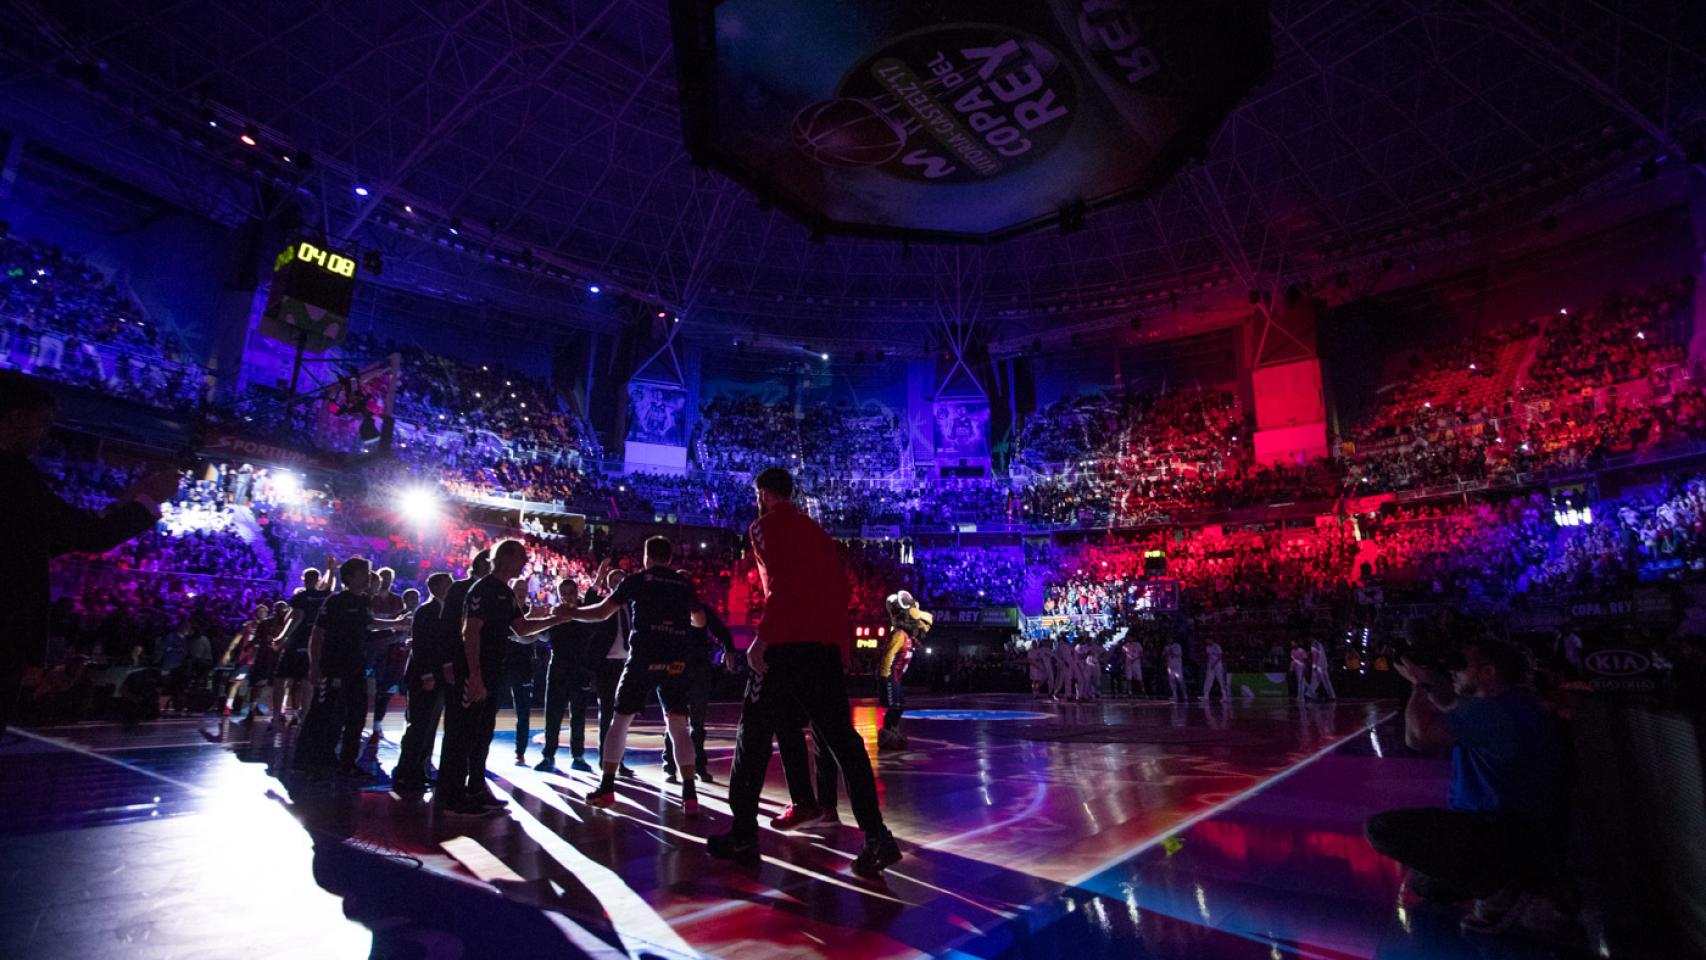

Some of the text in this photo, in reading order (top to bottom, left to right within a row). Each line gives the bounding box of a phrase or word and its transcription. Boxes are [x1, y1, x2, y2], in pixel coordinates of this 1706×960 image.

[960, 38, 1069, 130] REY
[928, 50, 1032, 157] COPA DEL
[959, 611, 980, 623] REY
[1571, 602, 1600, 616] COPA
[1595, 655, 1640, 671] KIA
